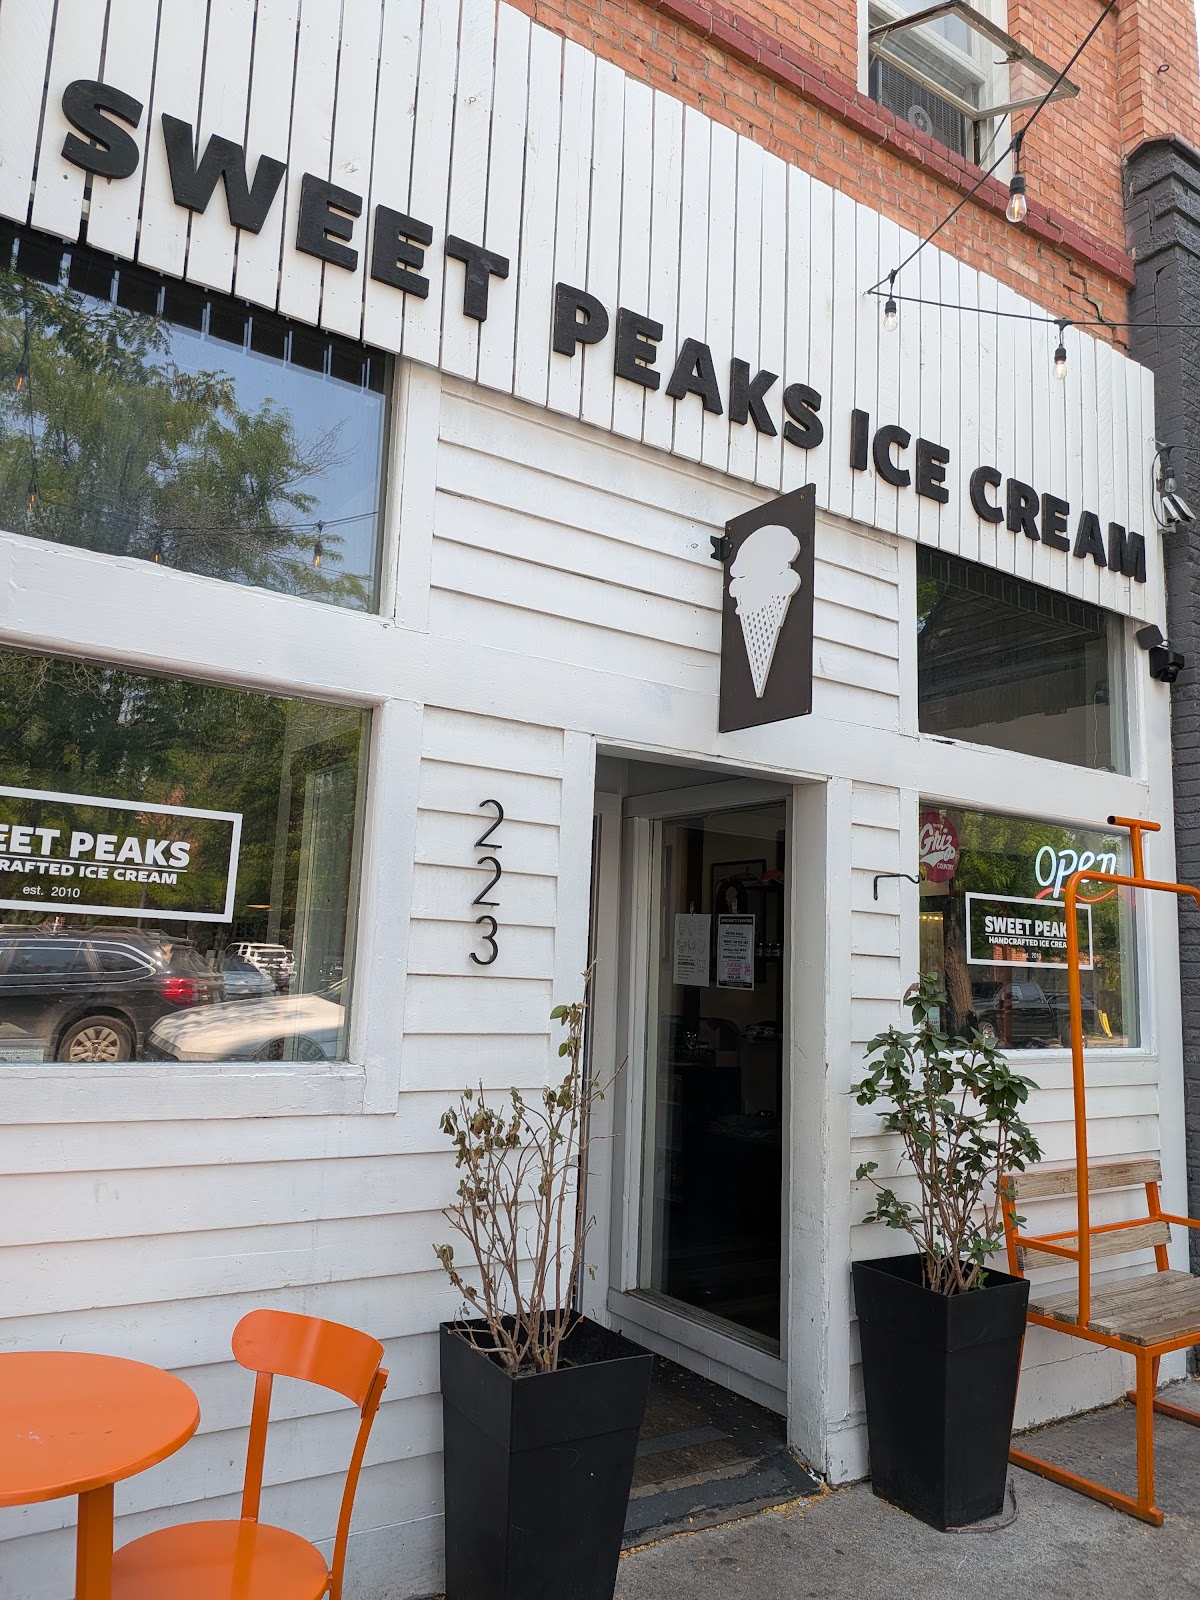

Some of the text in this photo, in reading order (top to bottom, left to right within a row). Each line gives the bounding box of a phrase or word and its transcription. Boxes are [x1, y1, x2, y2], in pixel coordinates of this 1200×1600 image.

[61, 79, 1147, 583] SWEET PEAKS ICE CREAM
[69, 831, 191, 868] PEAKS
[78, 865, 109, 880] ICE
[113, 868, 178, 885] CREAM
[1035, 845, 1117, 898] Open
[22, 886, 80, 898] est. 2010
[985, 915, 1032, 935] SWEET
[989, 936, 1038, 947] HANDCRAFTED
